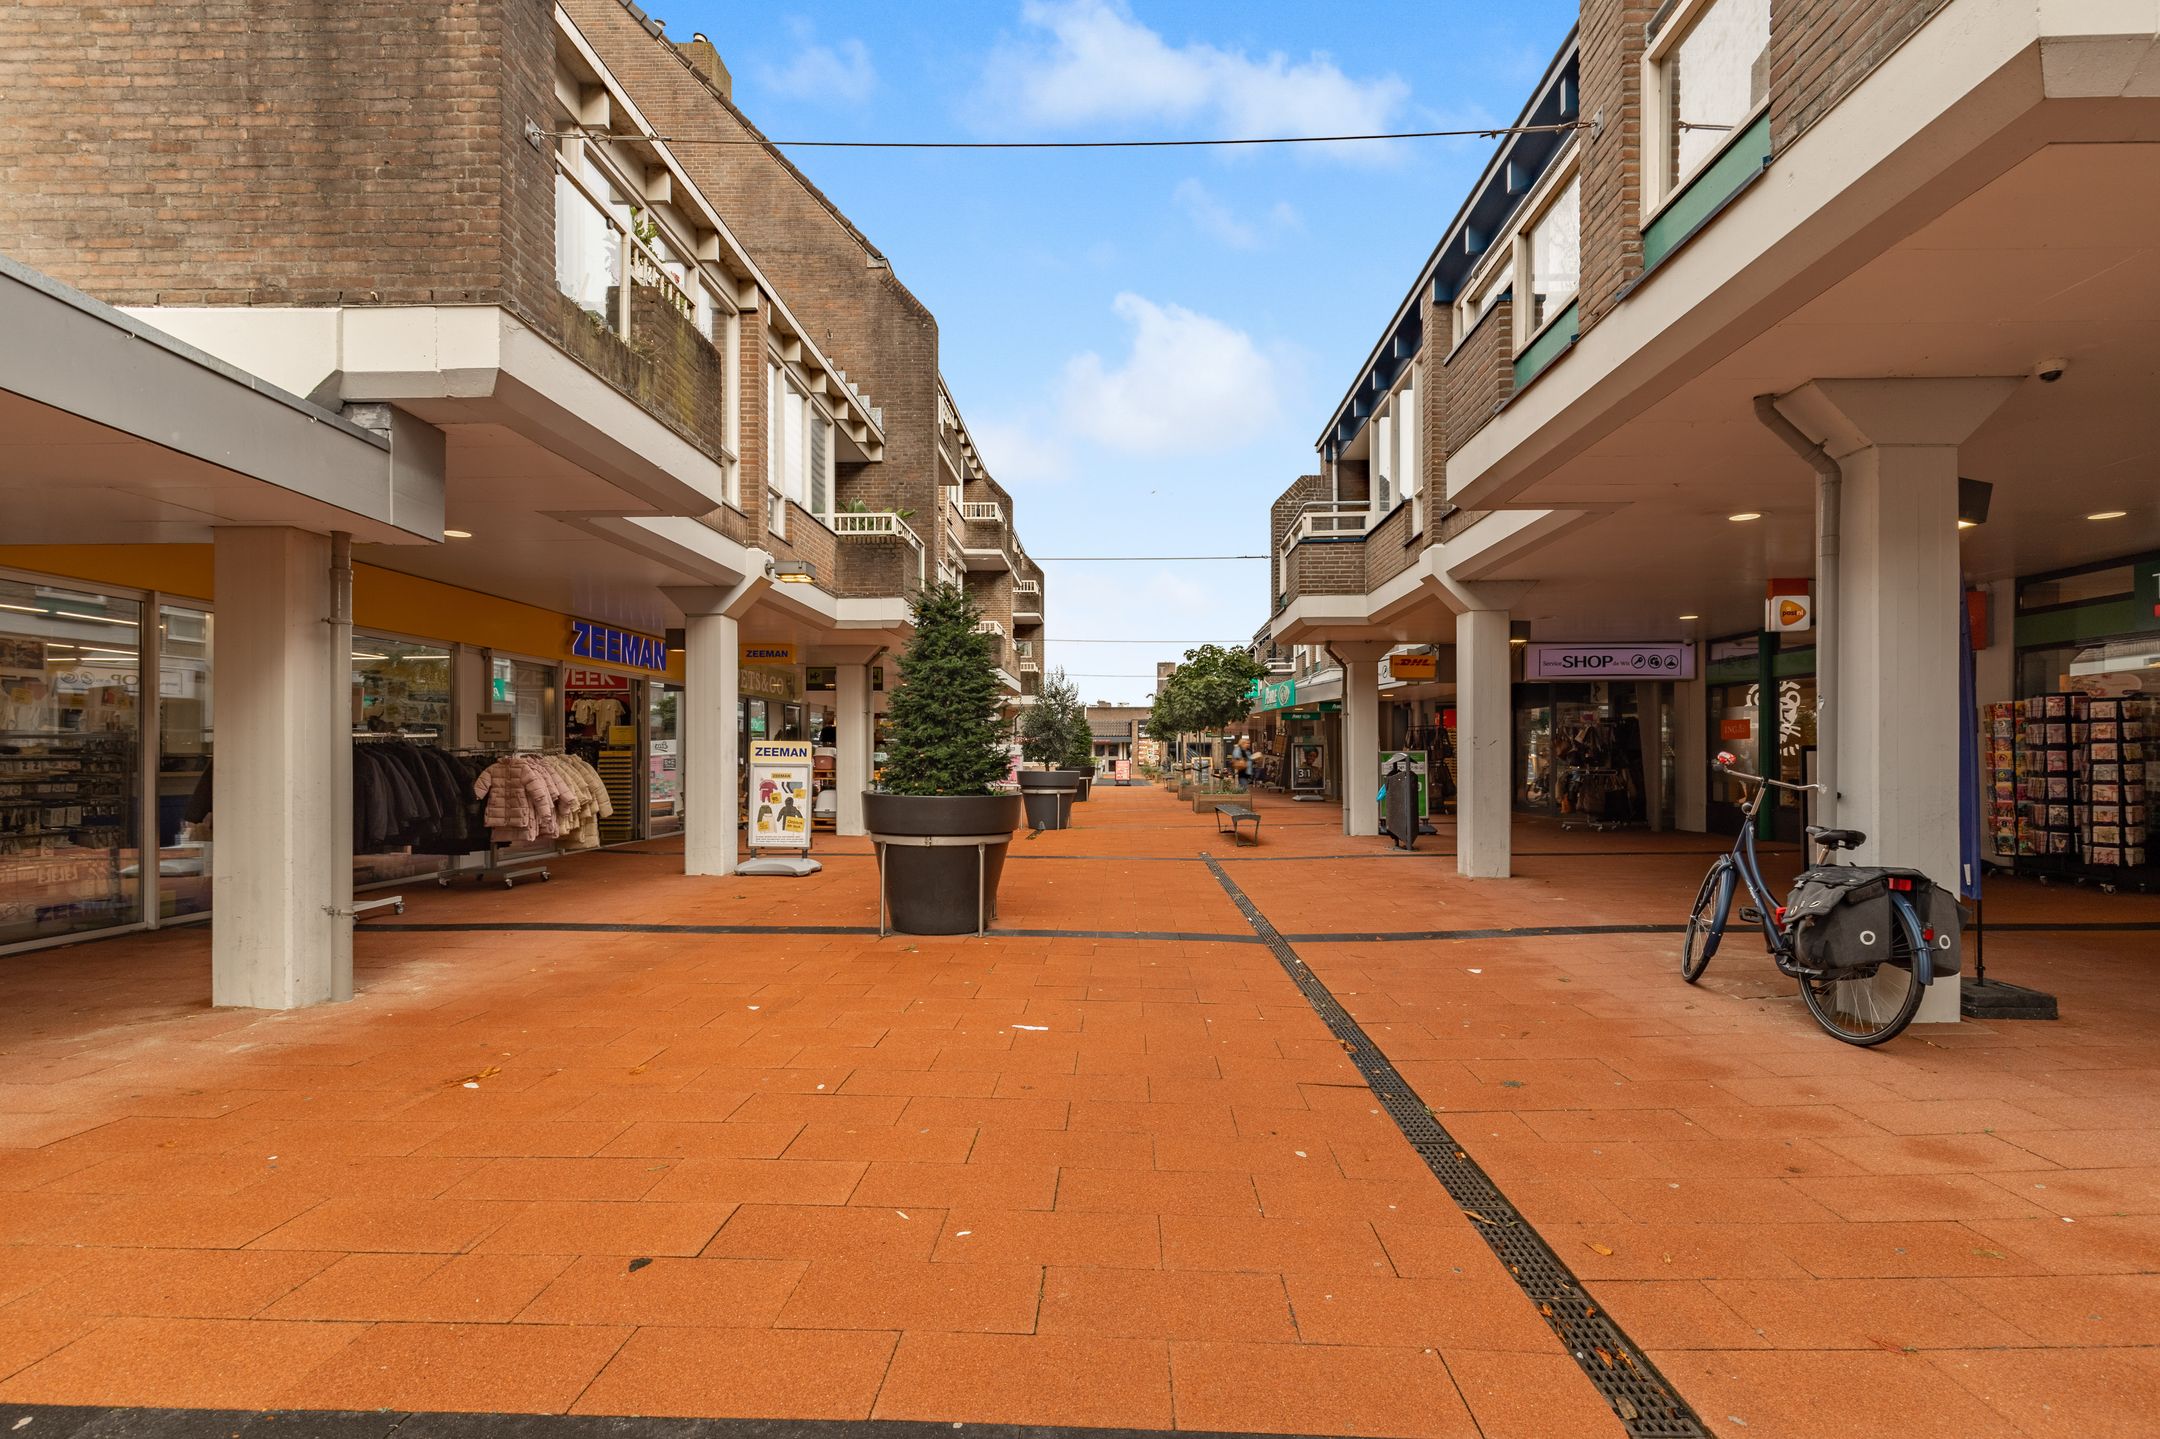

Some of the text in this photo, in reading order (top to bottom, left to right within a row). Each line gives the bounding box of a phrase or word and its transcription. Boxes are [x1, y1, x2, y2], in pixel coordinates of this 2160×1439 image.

[572, 621, 667, 671] ZEEMAN
[745, 649, 789, 658] ZEEMAN
[1400, 658, 1430, 666] DHL
[1562, 655, 1613, 668] SHOP
[739, 669, 784, 695] ETS&CO
[755, 747, 807, 757] ZEEMAN
